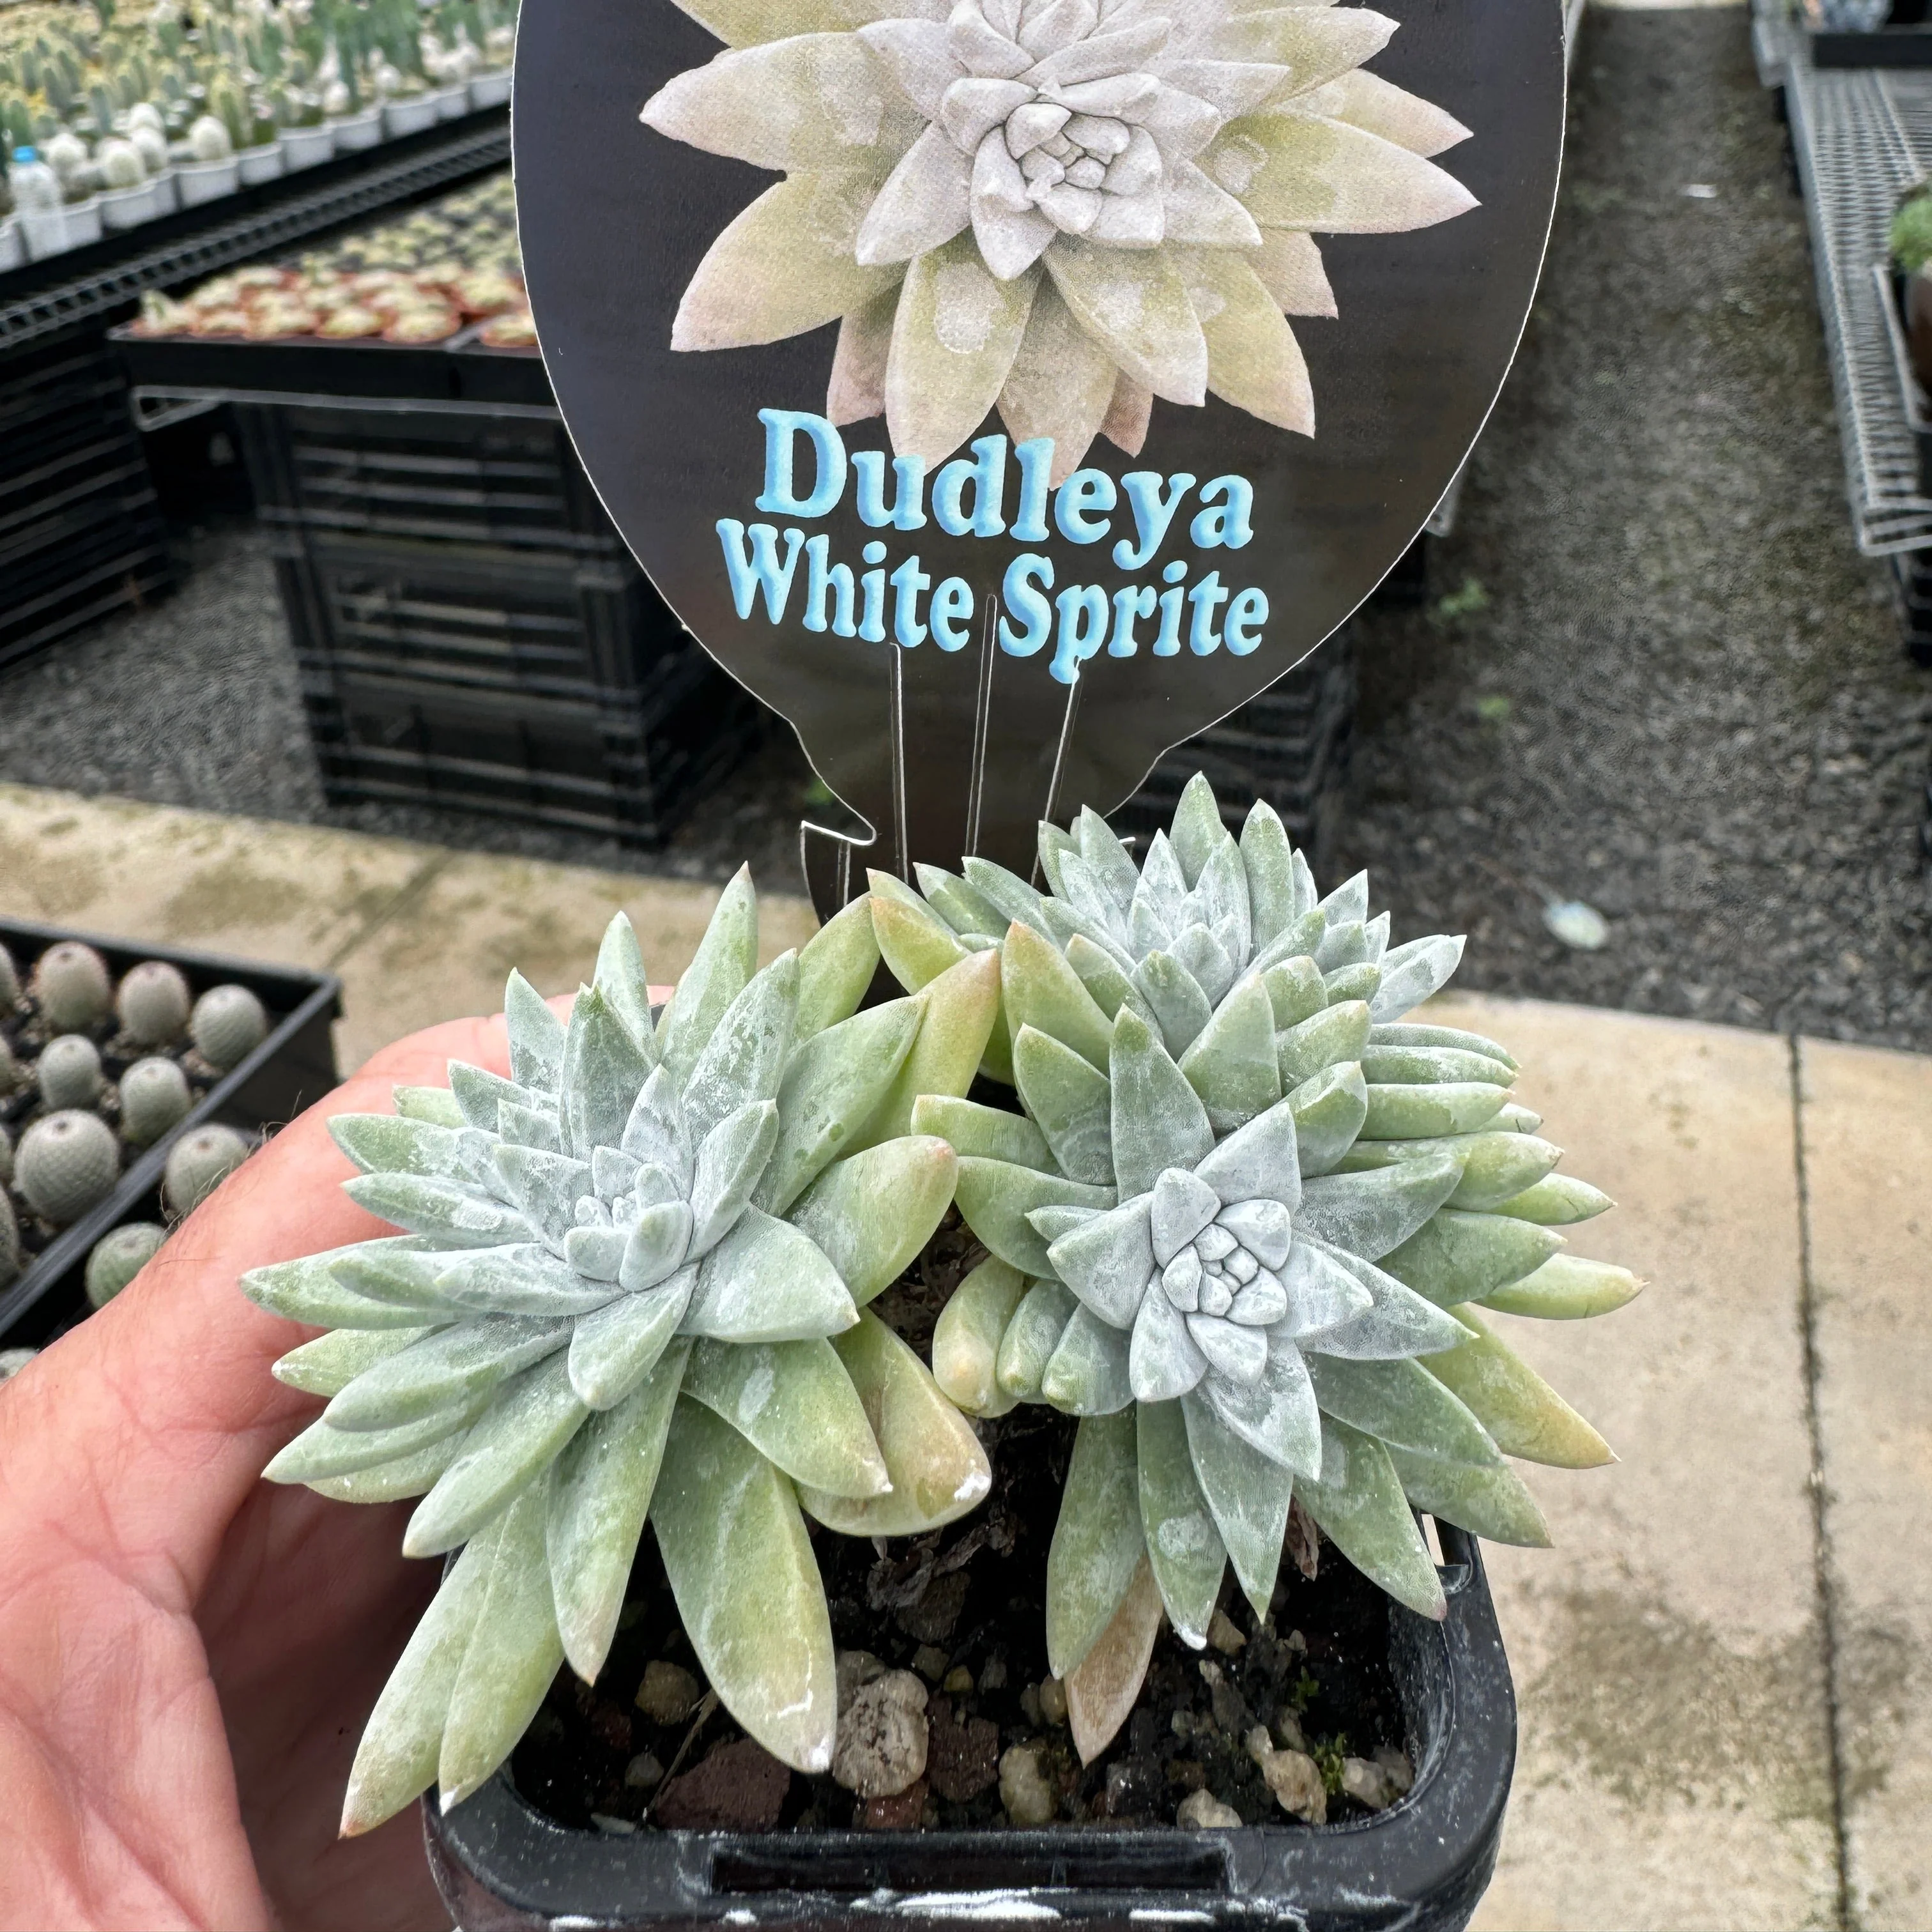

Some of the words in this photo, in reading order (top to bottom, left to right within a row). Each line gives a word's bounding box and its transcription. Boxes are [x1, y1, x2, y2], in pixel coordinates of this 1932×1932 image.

[755, 408, 1254, 571] Dudleya
[715, 518, 974, 652] White
[999, 553, 1269, 684] Sprite
